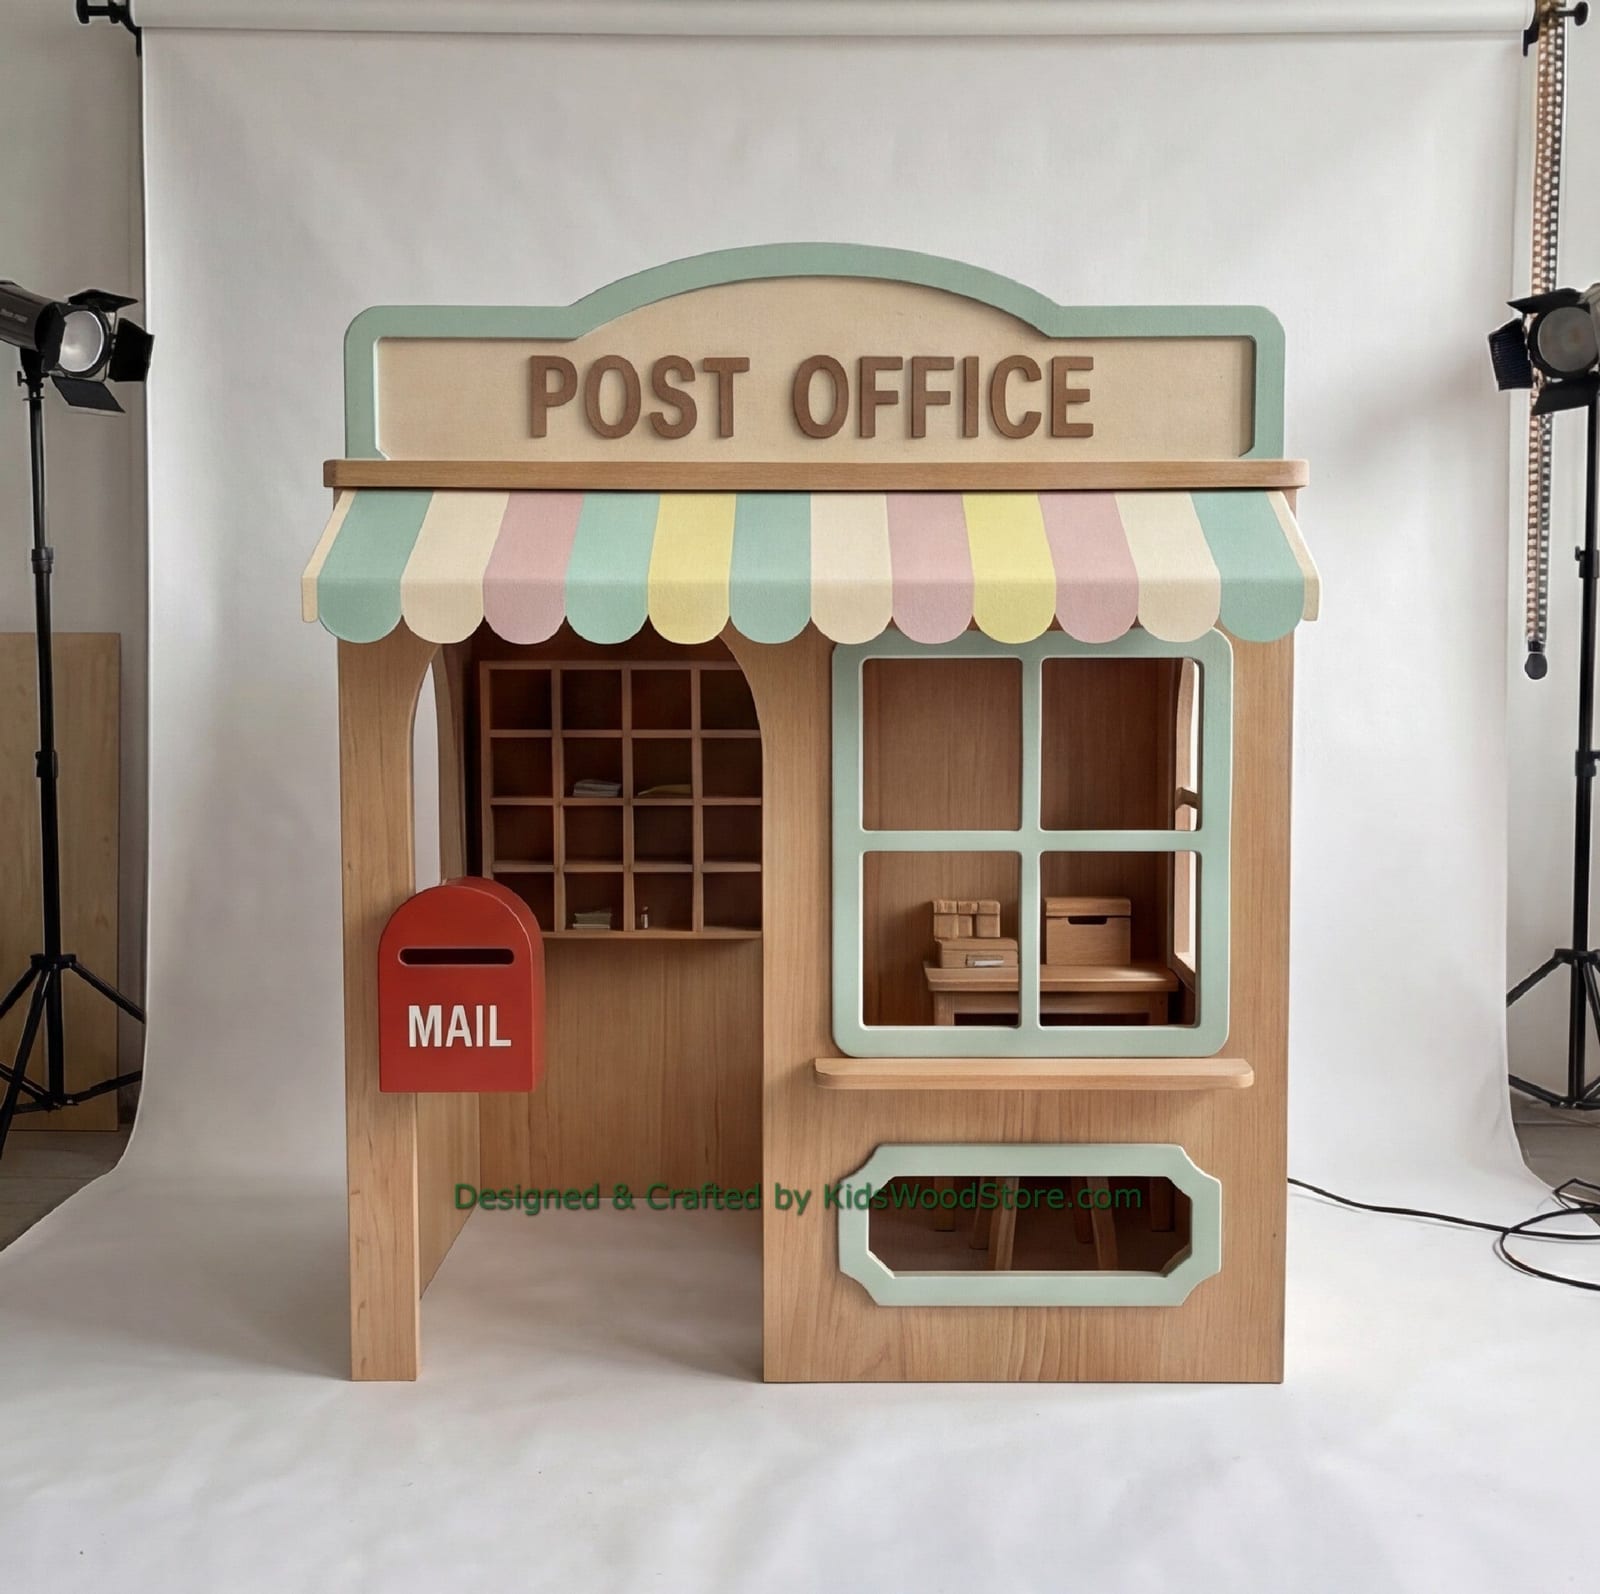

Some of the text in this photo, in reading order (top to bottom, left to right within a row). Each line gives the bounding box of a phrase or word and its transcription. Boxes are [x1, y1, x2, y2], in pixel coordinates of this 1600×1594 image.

[527, 355, 1094, 440] POST OFFICE
[408, 1005, 512, 1048] MAIL
